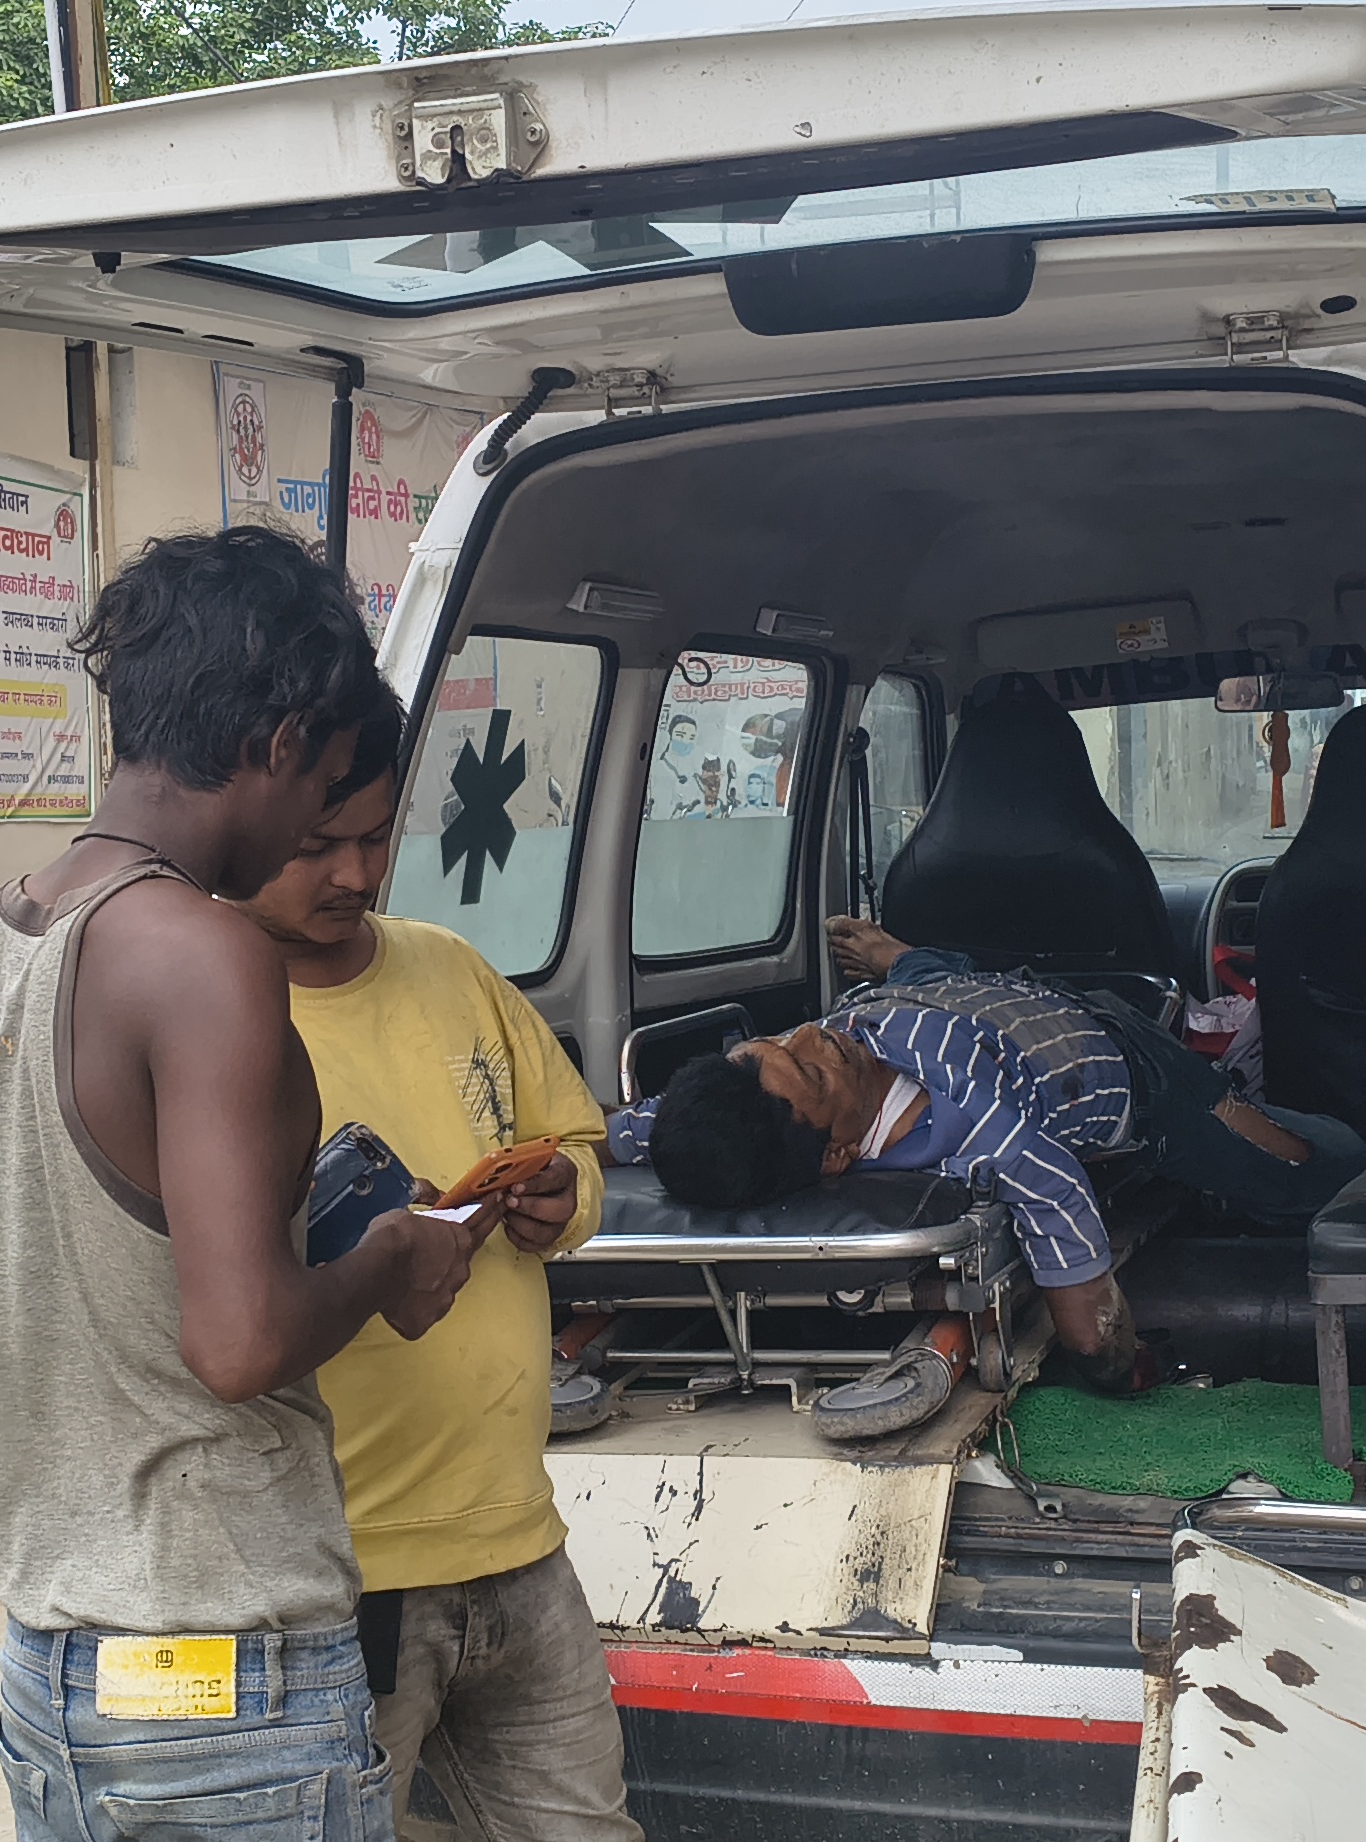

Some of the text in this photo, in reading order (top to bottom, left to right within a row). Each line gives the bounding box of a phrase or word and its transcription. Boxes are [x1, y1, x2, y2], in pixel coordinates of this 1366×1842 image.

[350, 472, 382, 520] दीदी
[386, 478, 411, 523] की
[36, 612, 68, 635] सरकारी
[3, 643, 12, 668] से
